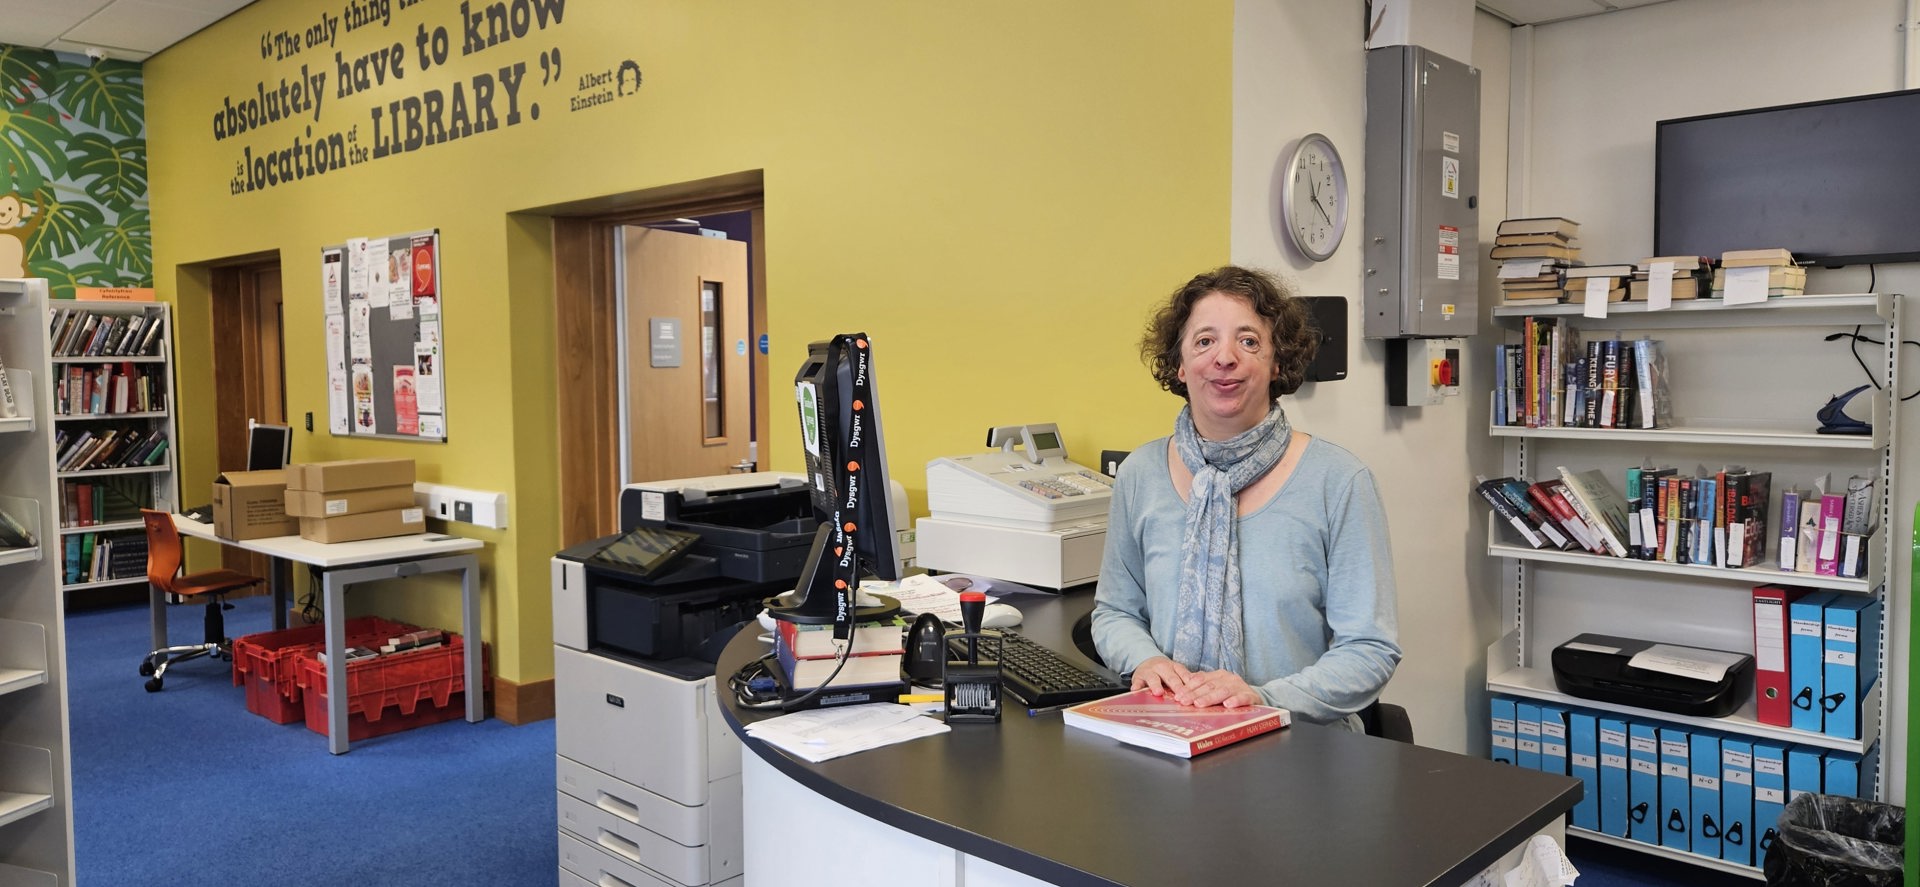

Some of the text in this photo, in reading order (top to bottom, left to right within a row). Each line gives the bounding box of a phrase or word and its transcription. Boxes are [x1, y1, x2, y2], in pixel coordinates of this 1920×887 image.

[306, 12, 338, 48] only
[344, 0, 390, 32] thing
[213, 0, 567, 141] absolutely have to know
[578, 69, 613, 92] Albert
[570, 89, 614, 113] Einstein
[347, 125, 358, 143] of
[244, 125, 347, 192] location
[348, 143, 369, 167] the
[1299, 158, 1306, 169] 11
[1309, 154, 1316, 165] 12
[236, 161, 244, 178] is
[230, 176, 245, 196] the
[855, 352, 866, 386] Dysgwr
[1604, 355, 1616, 383] FURY
[1588, 358, 1597, 419] KILLING TIME
[850, 414, 861, 448] Dysgwr
[846, 475, 857, 509] Dysgwr
[1482, 489, 1499, 510] Harlan
[1646, 483, 1654, 497] LEE
[840, 535, 853, 568] Dysgwr
[837, 592, 847, 622] Dysgwr
[1197, 741, 1214, 751] Wales
